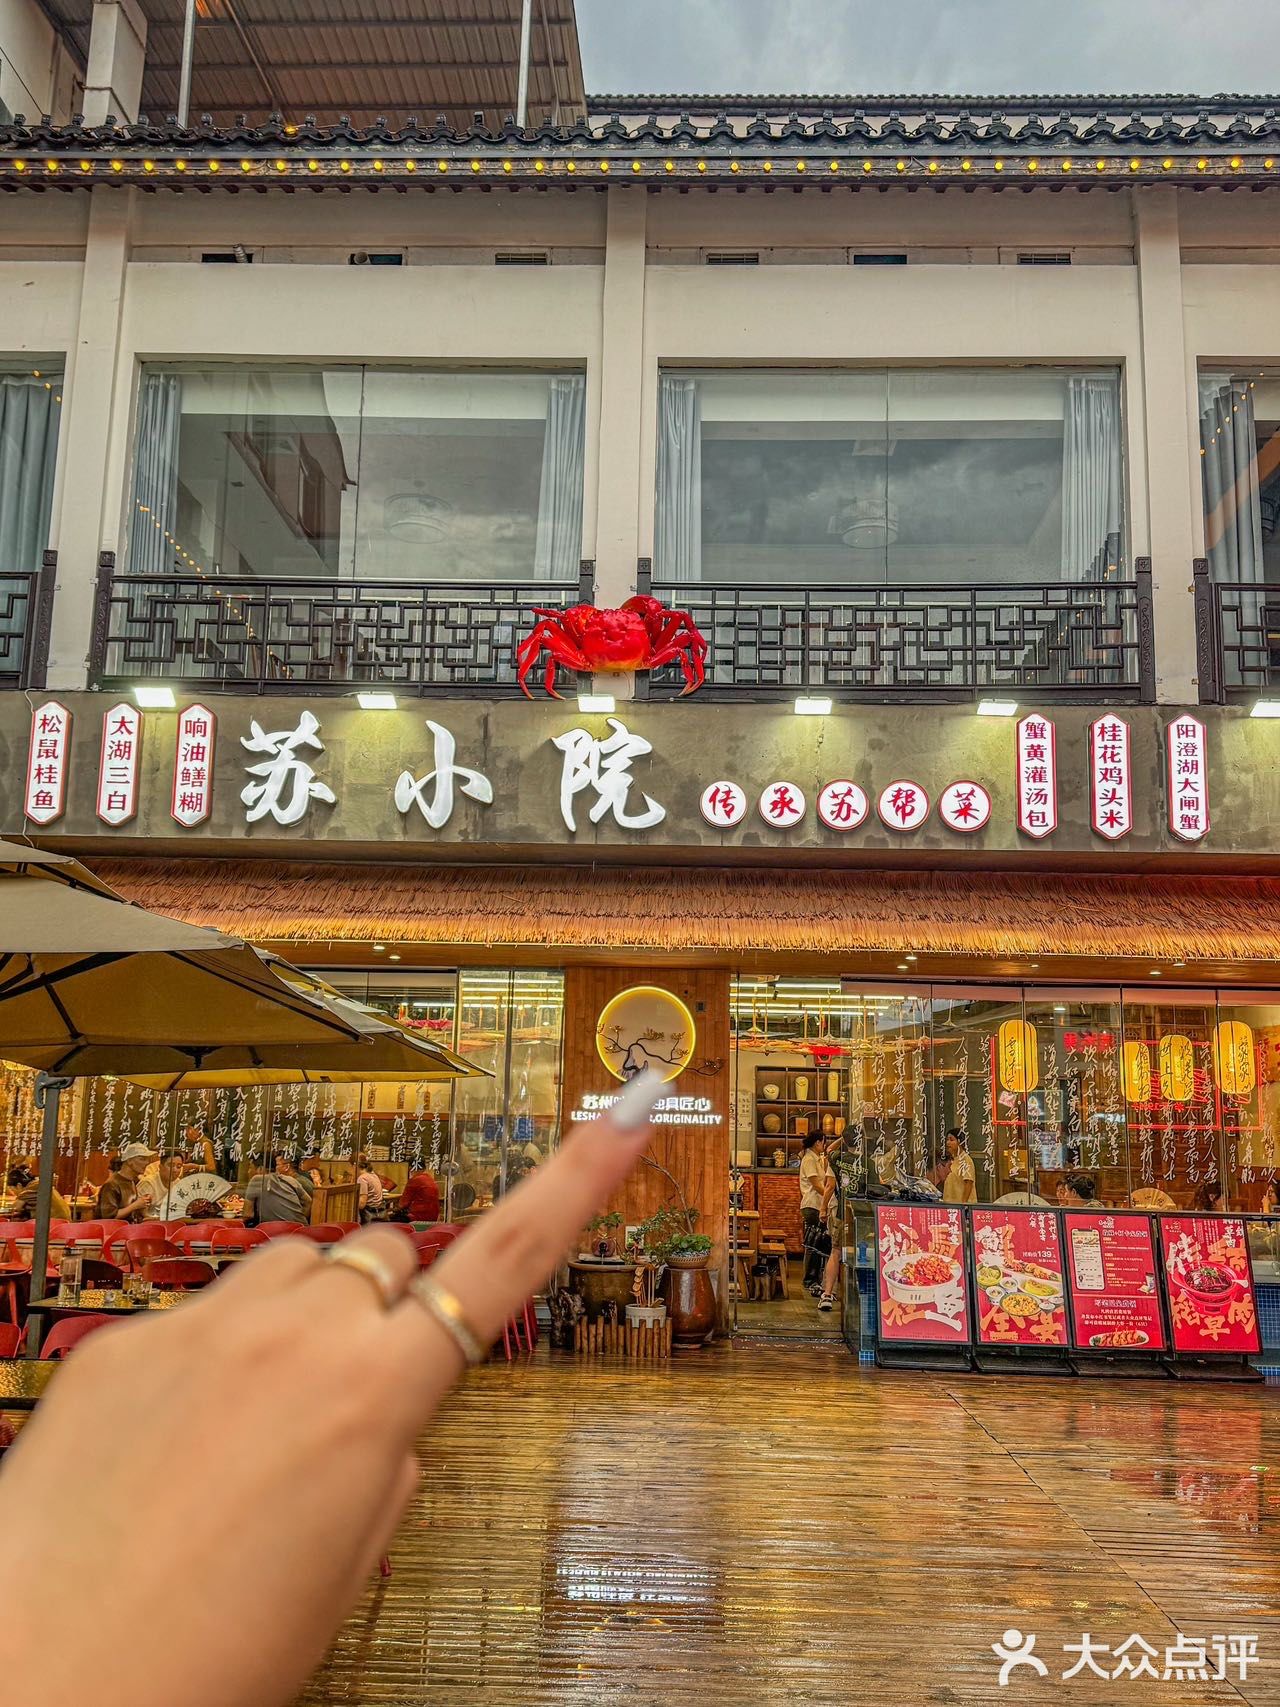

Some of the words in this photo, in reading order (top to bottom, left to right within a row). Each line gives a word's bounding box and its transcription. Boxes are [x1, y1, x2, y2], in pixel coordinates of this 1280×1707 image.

[32, 714, 63, 810] 松鼠桂鱼
[106, 716, 134, 811] 太湖三白
[178, 718, 208, 813] 响油鳝糊
[241, 711, 667, 831] 苏小院
[709, 786, 978, 826] 传承苏帮菜
[1024, 722, 1049, 828] 蟹黄灌汤包
[1097, 723, 1125, 829] 桂花鸡头米
[1176, 724, 1200, 830] 阳澄湖大闸蟹
